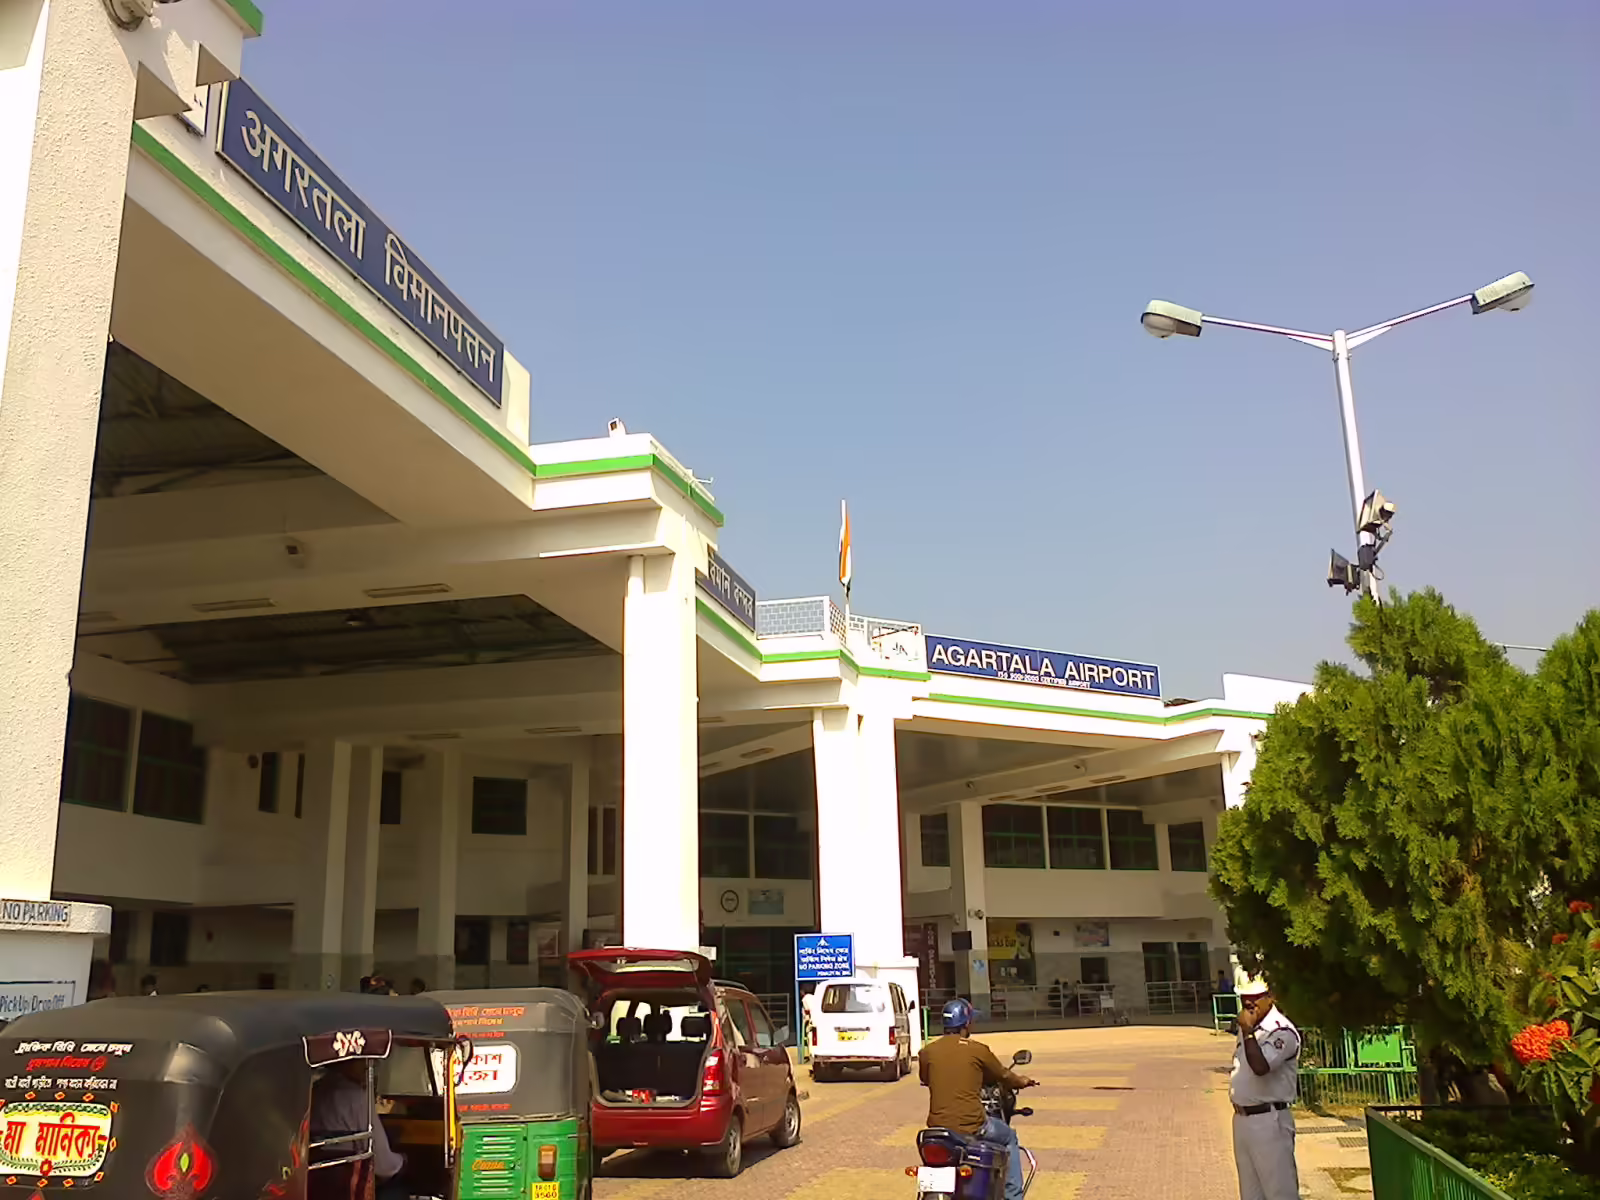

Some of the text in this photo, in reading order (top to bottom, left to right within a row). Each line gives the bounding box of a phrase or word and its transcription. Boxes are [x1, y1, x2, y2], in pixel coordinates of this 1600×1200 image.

[241, 110, 366, 260] अगरतला
[932, 643, 1056, 677] AGARTALA
[1064, 660, 1155, 691] AIRPORT
[3, 901, 69, 923] NO PARKING
[4, 1121, 26, 1155] মা
